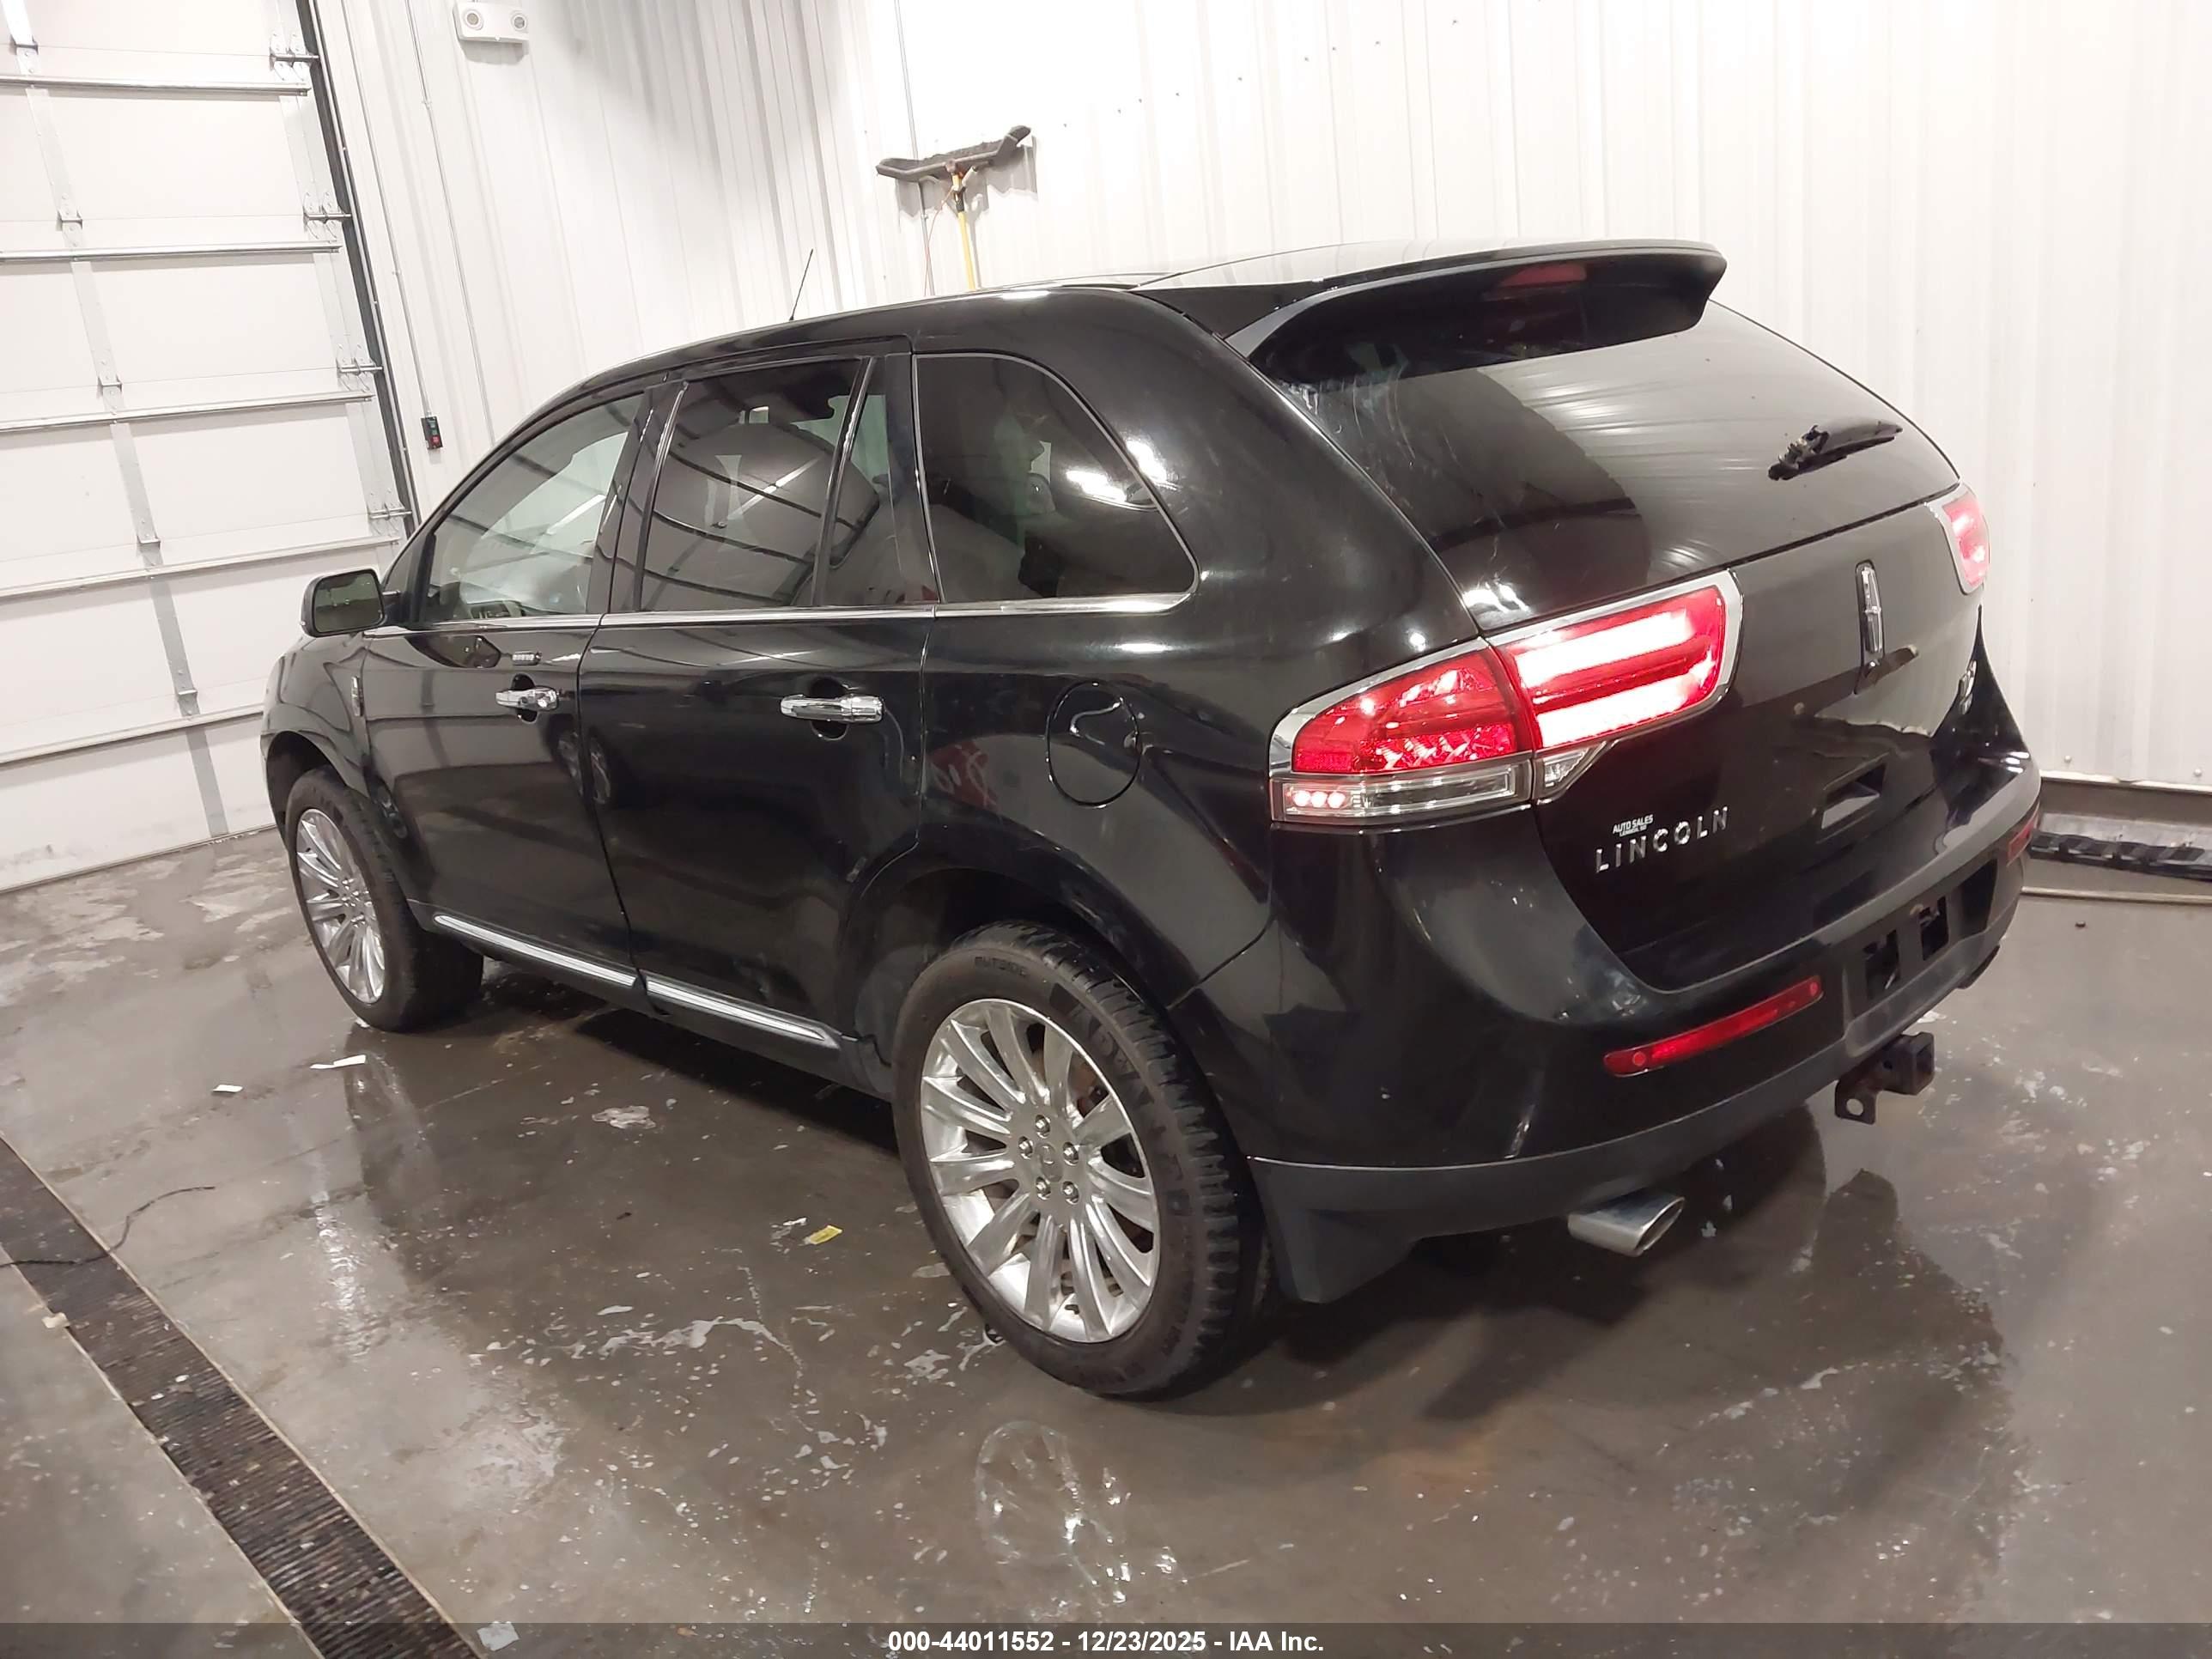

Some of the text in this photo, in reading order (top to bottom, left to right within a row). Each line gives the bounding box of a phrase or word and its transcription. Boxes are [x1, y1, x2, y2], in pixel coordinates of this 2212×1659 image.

[1595, 805, 1728, 873] LINCOLN
[1613, 820, 1632, 835] AUTO
[1632, 814, 1654, 829] SALES
